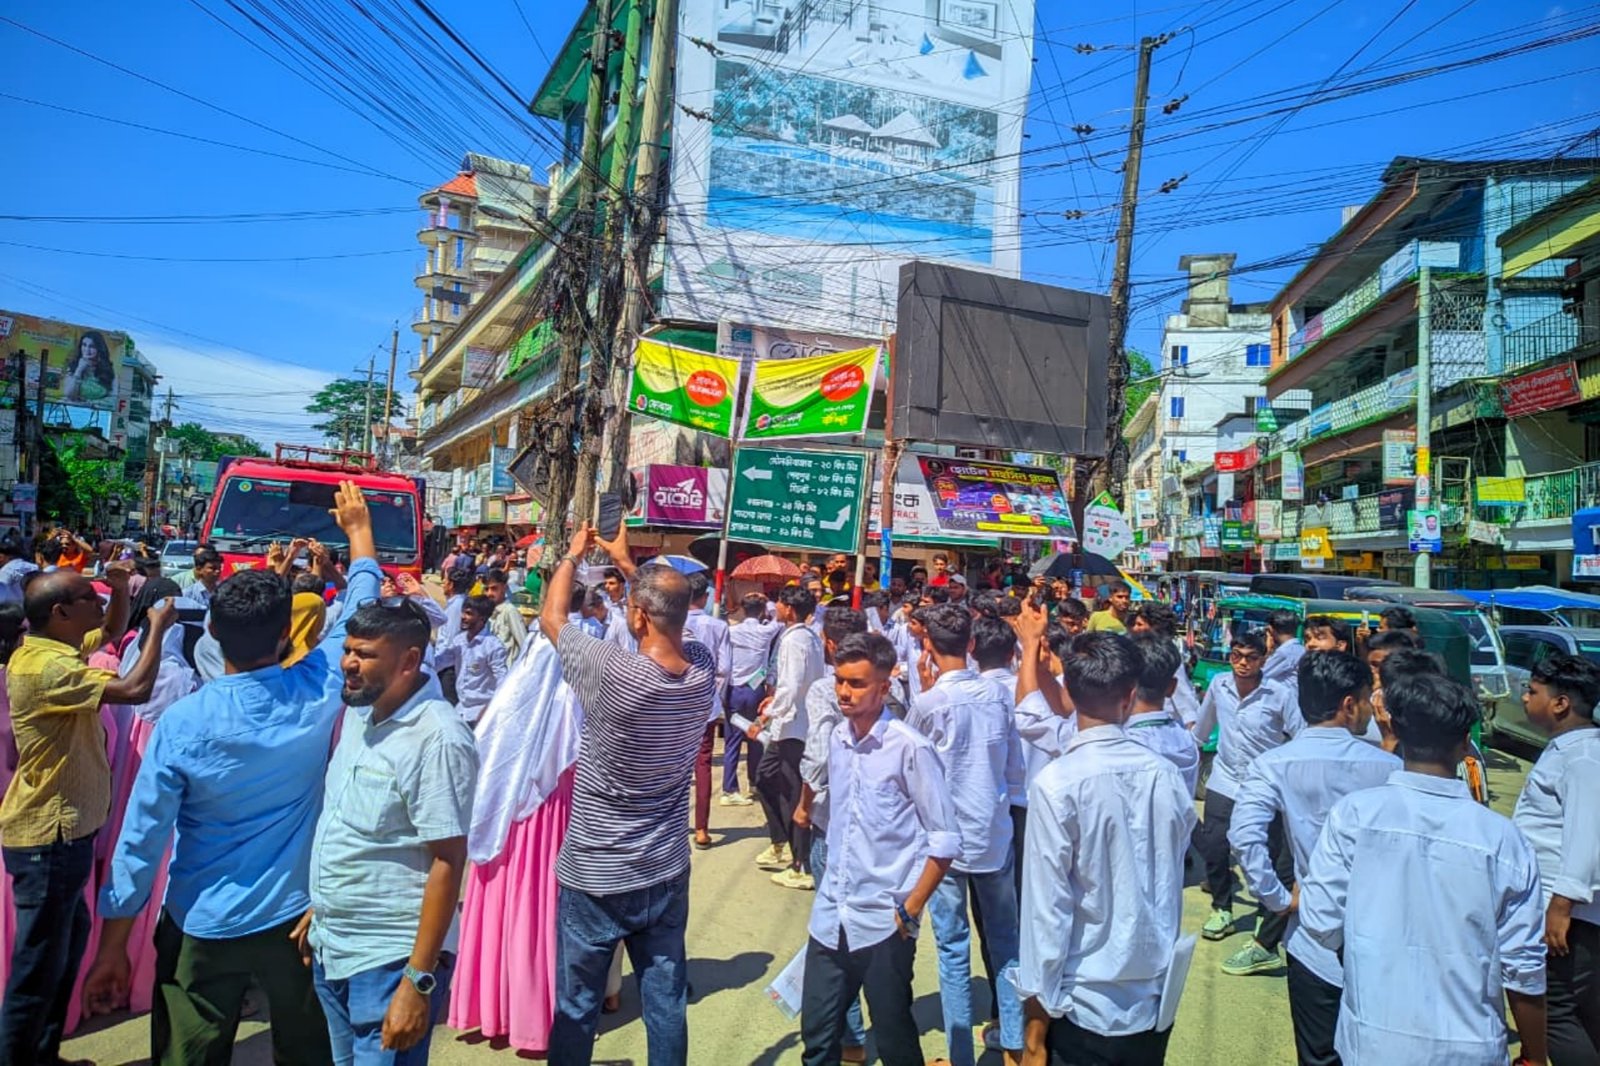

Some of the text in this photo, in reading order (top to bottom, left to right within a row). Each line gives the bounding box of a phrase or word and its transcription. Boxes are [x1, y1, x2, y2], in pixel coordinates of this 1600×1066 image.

[820, 461, 832, 470] ২০
[949, 466, 989, 477] হোটেল
[653, 483, 704, 507] রকেট
[789, 482, 810, 494] সিলেট
[817, 488, 829, 496] ৮২
